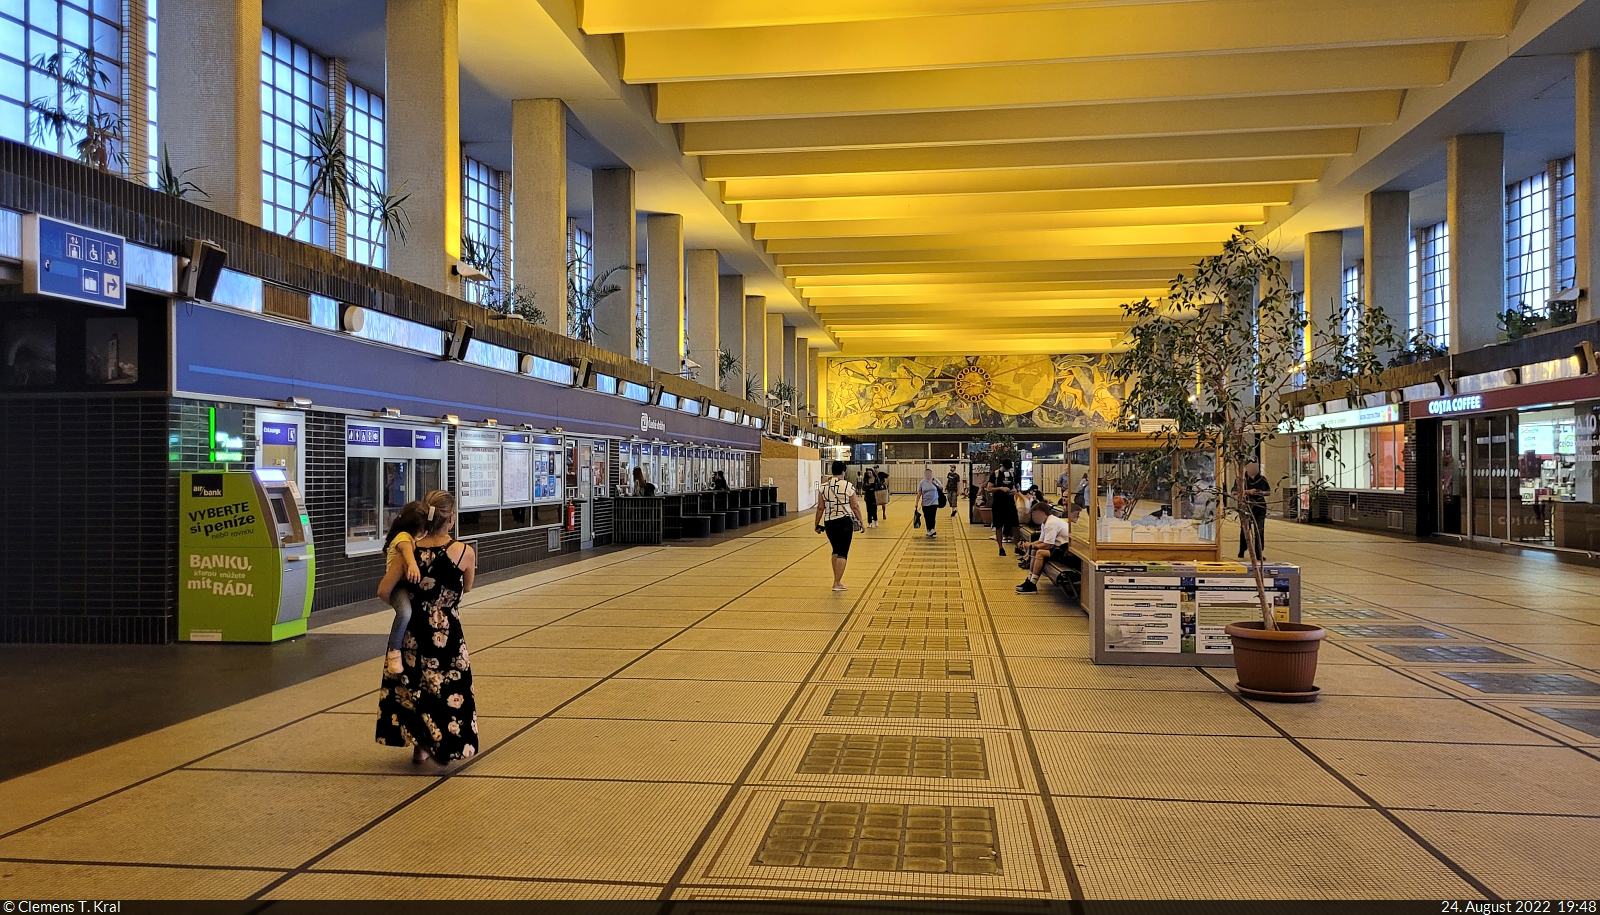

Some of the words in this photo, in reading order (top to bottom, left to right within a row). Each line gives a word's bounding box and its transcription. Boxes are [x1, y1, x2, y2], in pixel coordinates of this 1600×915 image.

[1428, 400, 1452, 414] COSTA
[1452, 396, 1481, 411] COFFEE
[188, 502, 249, 522] VYBERTE
[190, 524, 202, 534] si
[204, 513, 255, 537] peníze
[212, 531, 229, 540] nebo
[231, 528, 254, 538] rovnou
[190, 554, 252, 571] BANKU,
[220, 570, 246, 579] můžete
[187, 578, 212, 590] mít
[213, 580, 254, 597] RÁDI.
